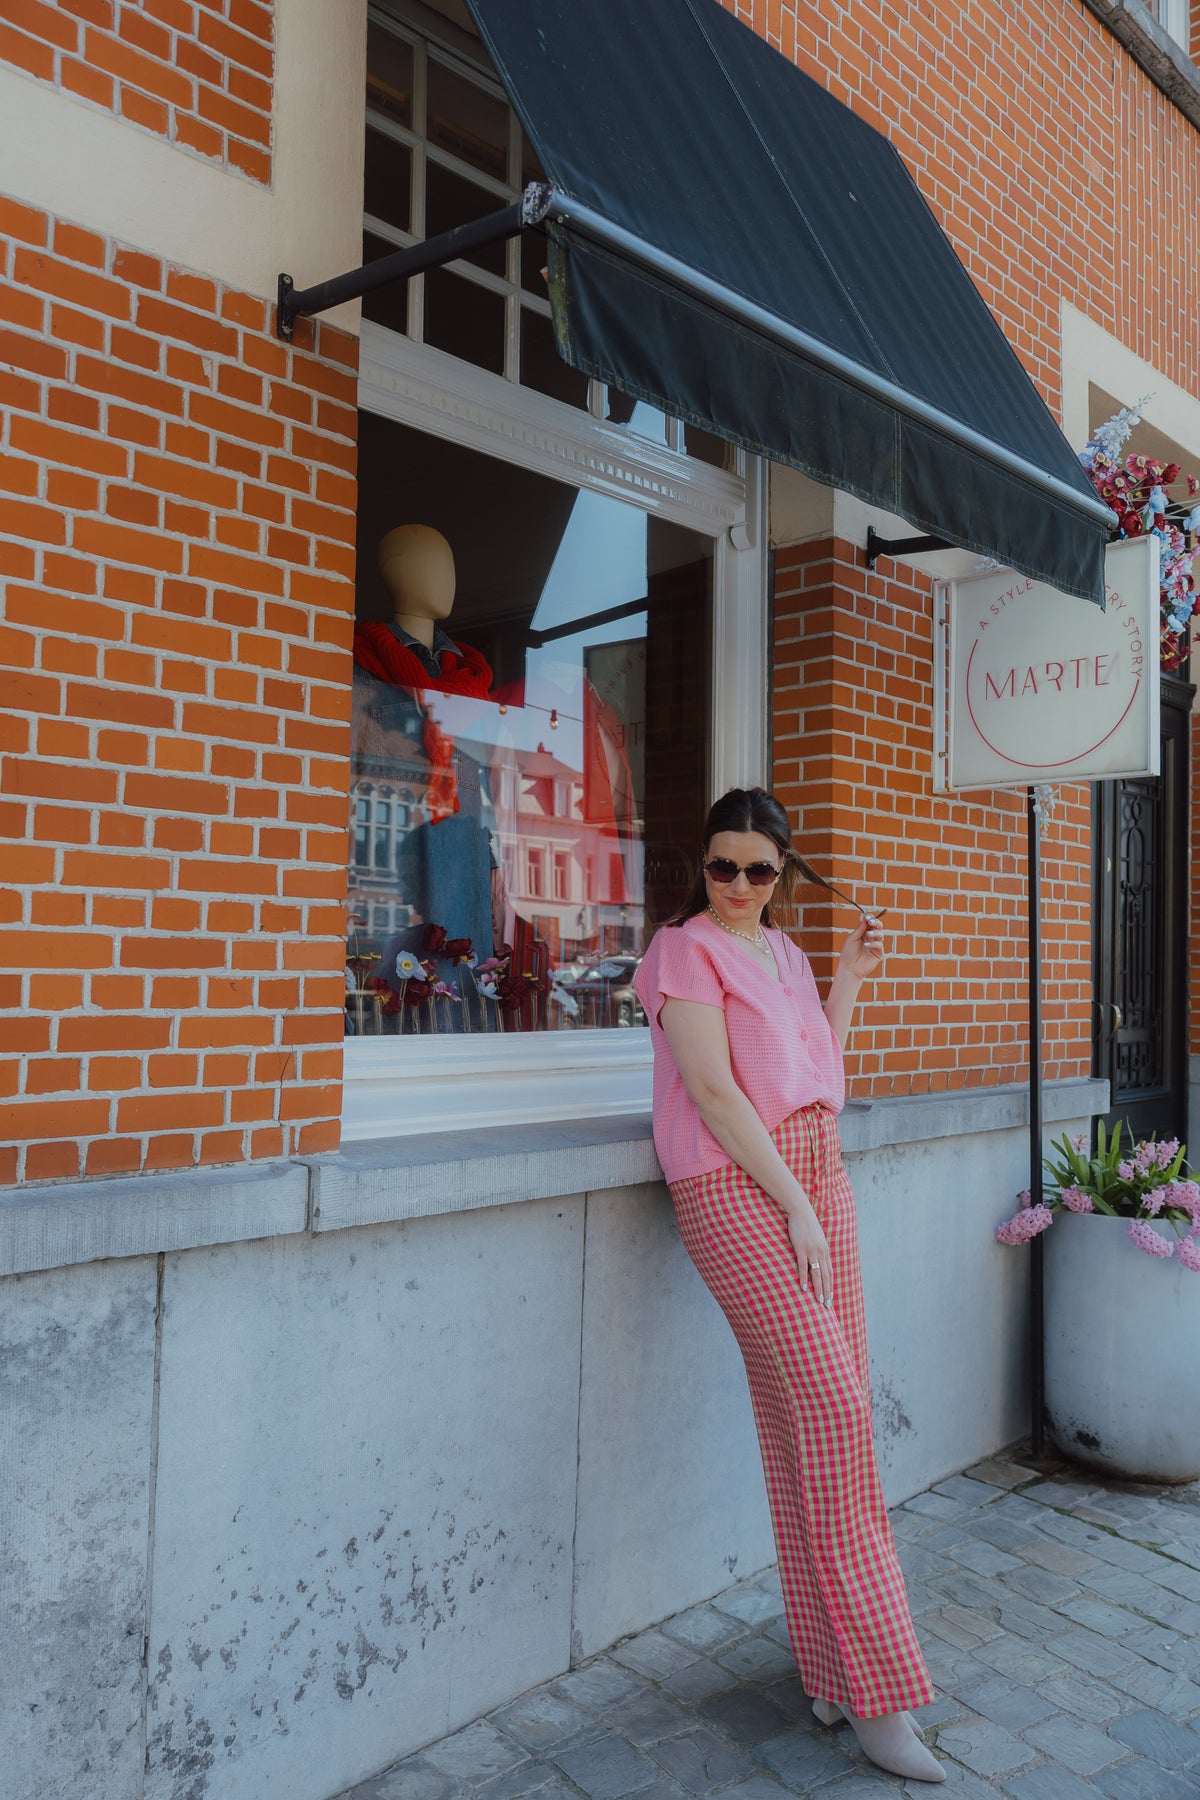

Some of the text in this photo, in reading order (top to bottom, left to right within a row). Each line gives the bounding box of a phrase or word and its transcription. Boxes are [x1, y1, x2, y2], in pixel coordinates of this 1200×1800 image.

[979, 621, 989, 631] A
[990, 578, 1033, 615] STYLE
[1122, 616, 1143, 677] STORY
[985, 654, 1109, 700] MARTE
